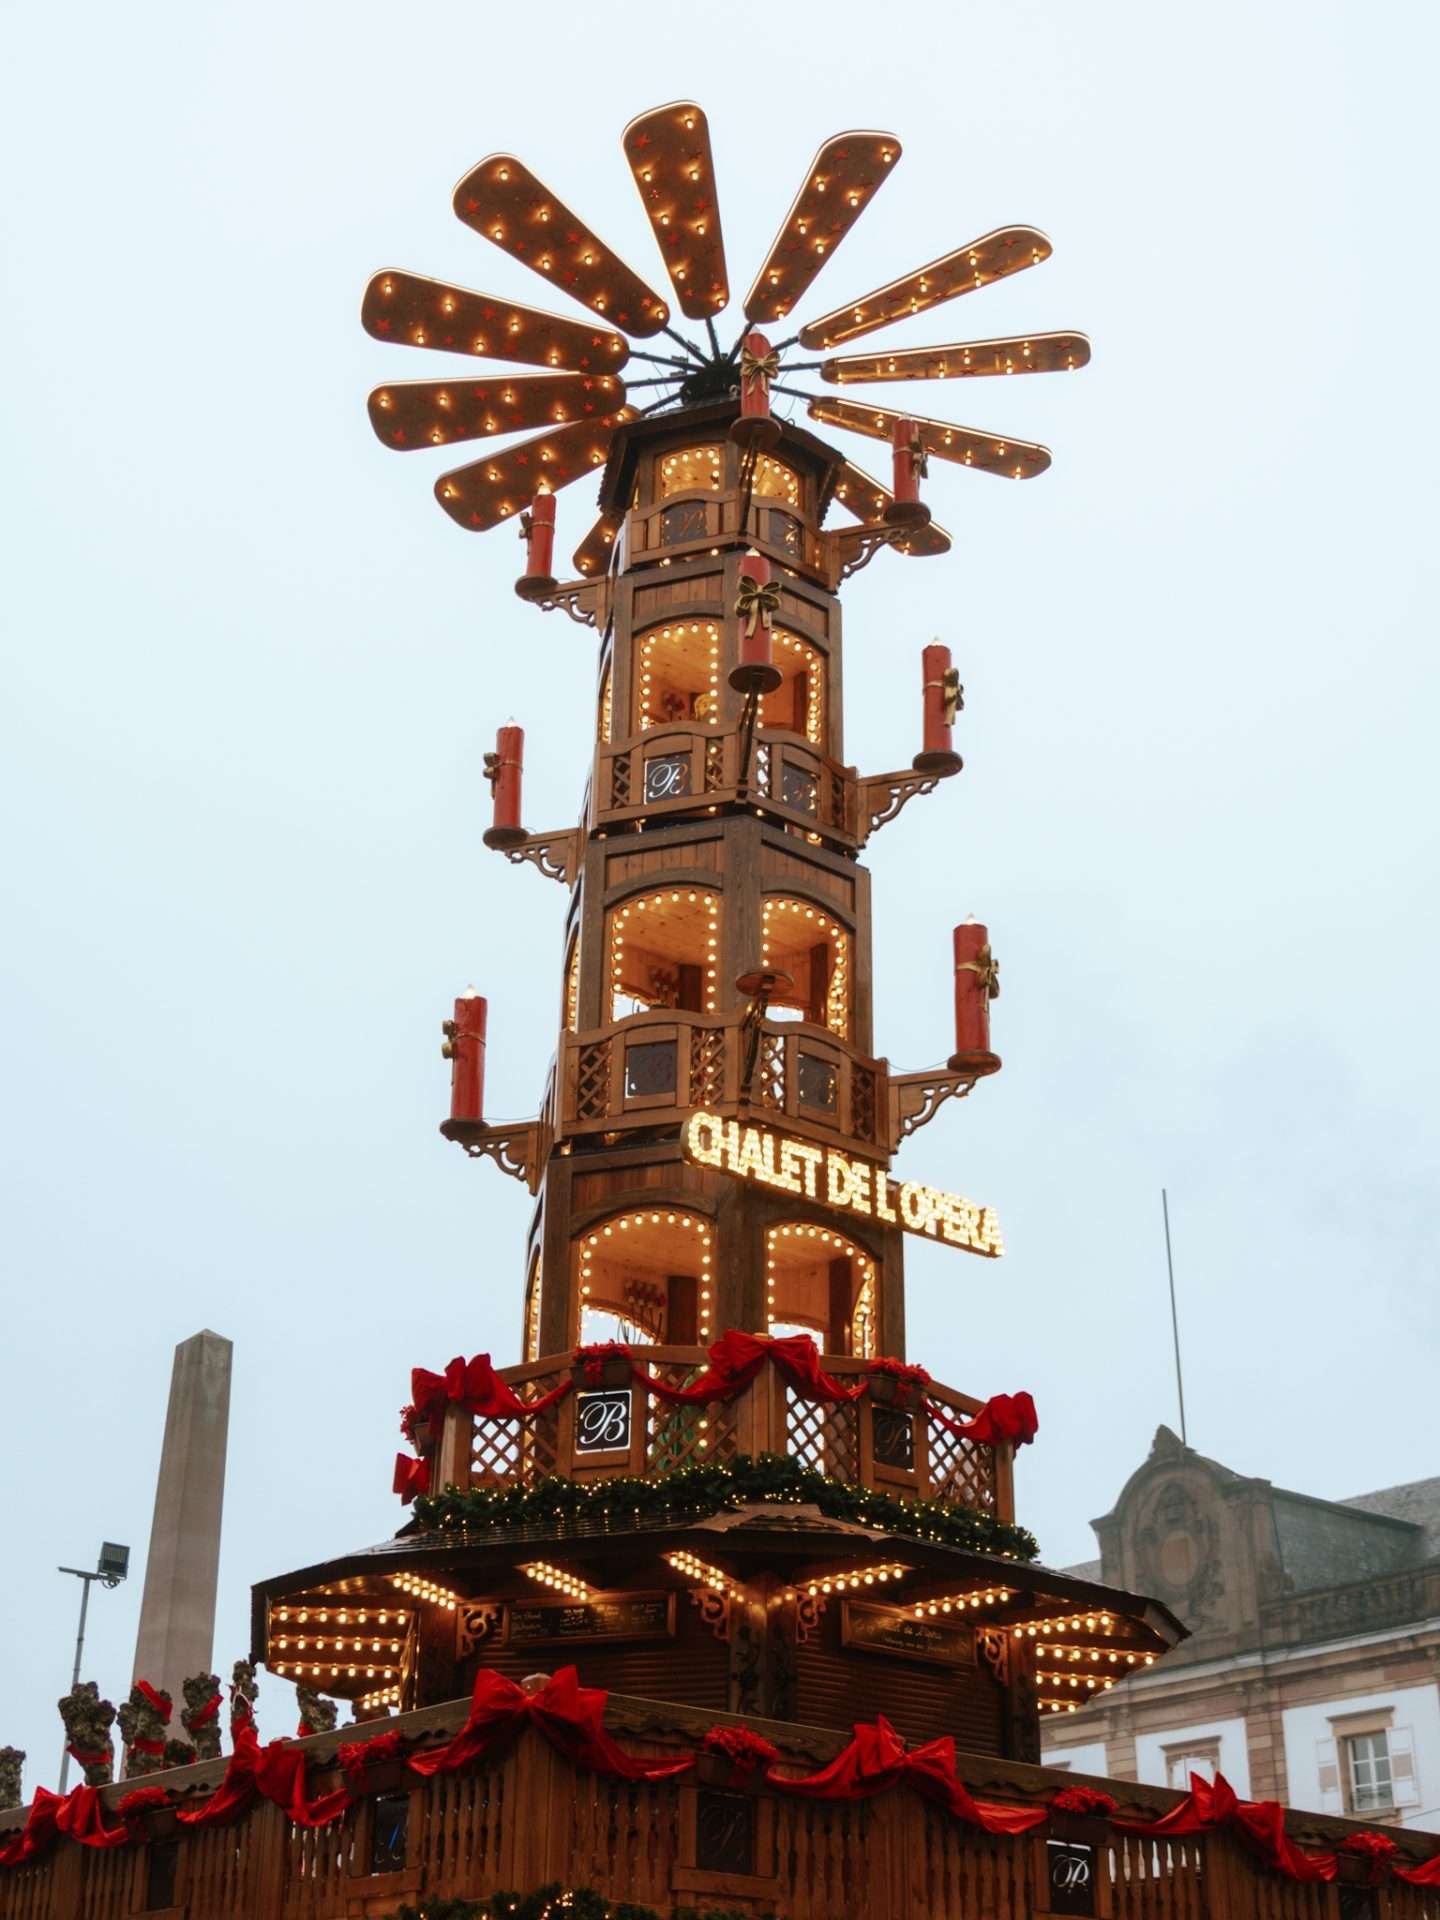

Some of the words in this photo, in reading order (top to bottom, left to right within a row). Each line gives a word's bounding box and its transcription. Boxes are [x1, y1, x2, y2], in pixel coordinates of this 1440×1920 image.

[688, 1112, 822, 1197] CHALET
[828, 1154, 871, 1214] DE
[579, 1400, 627, 1444] B
